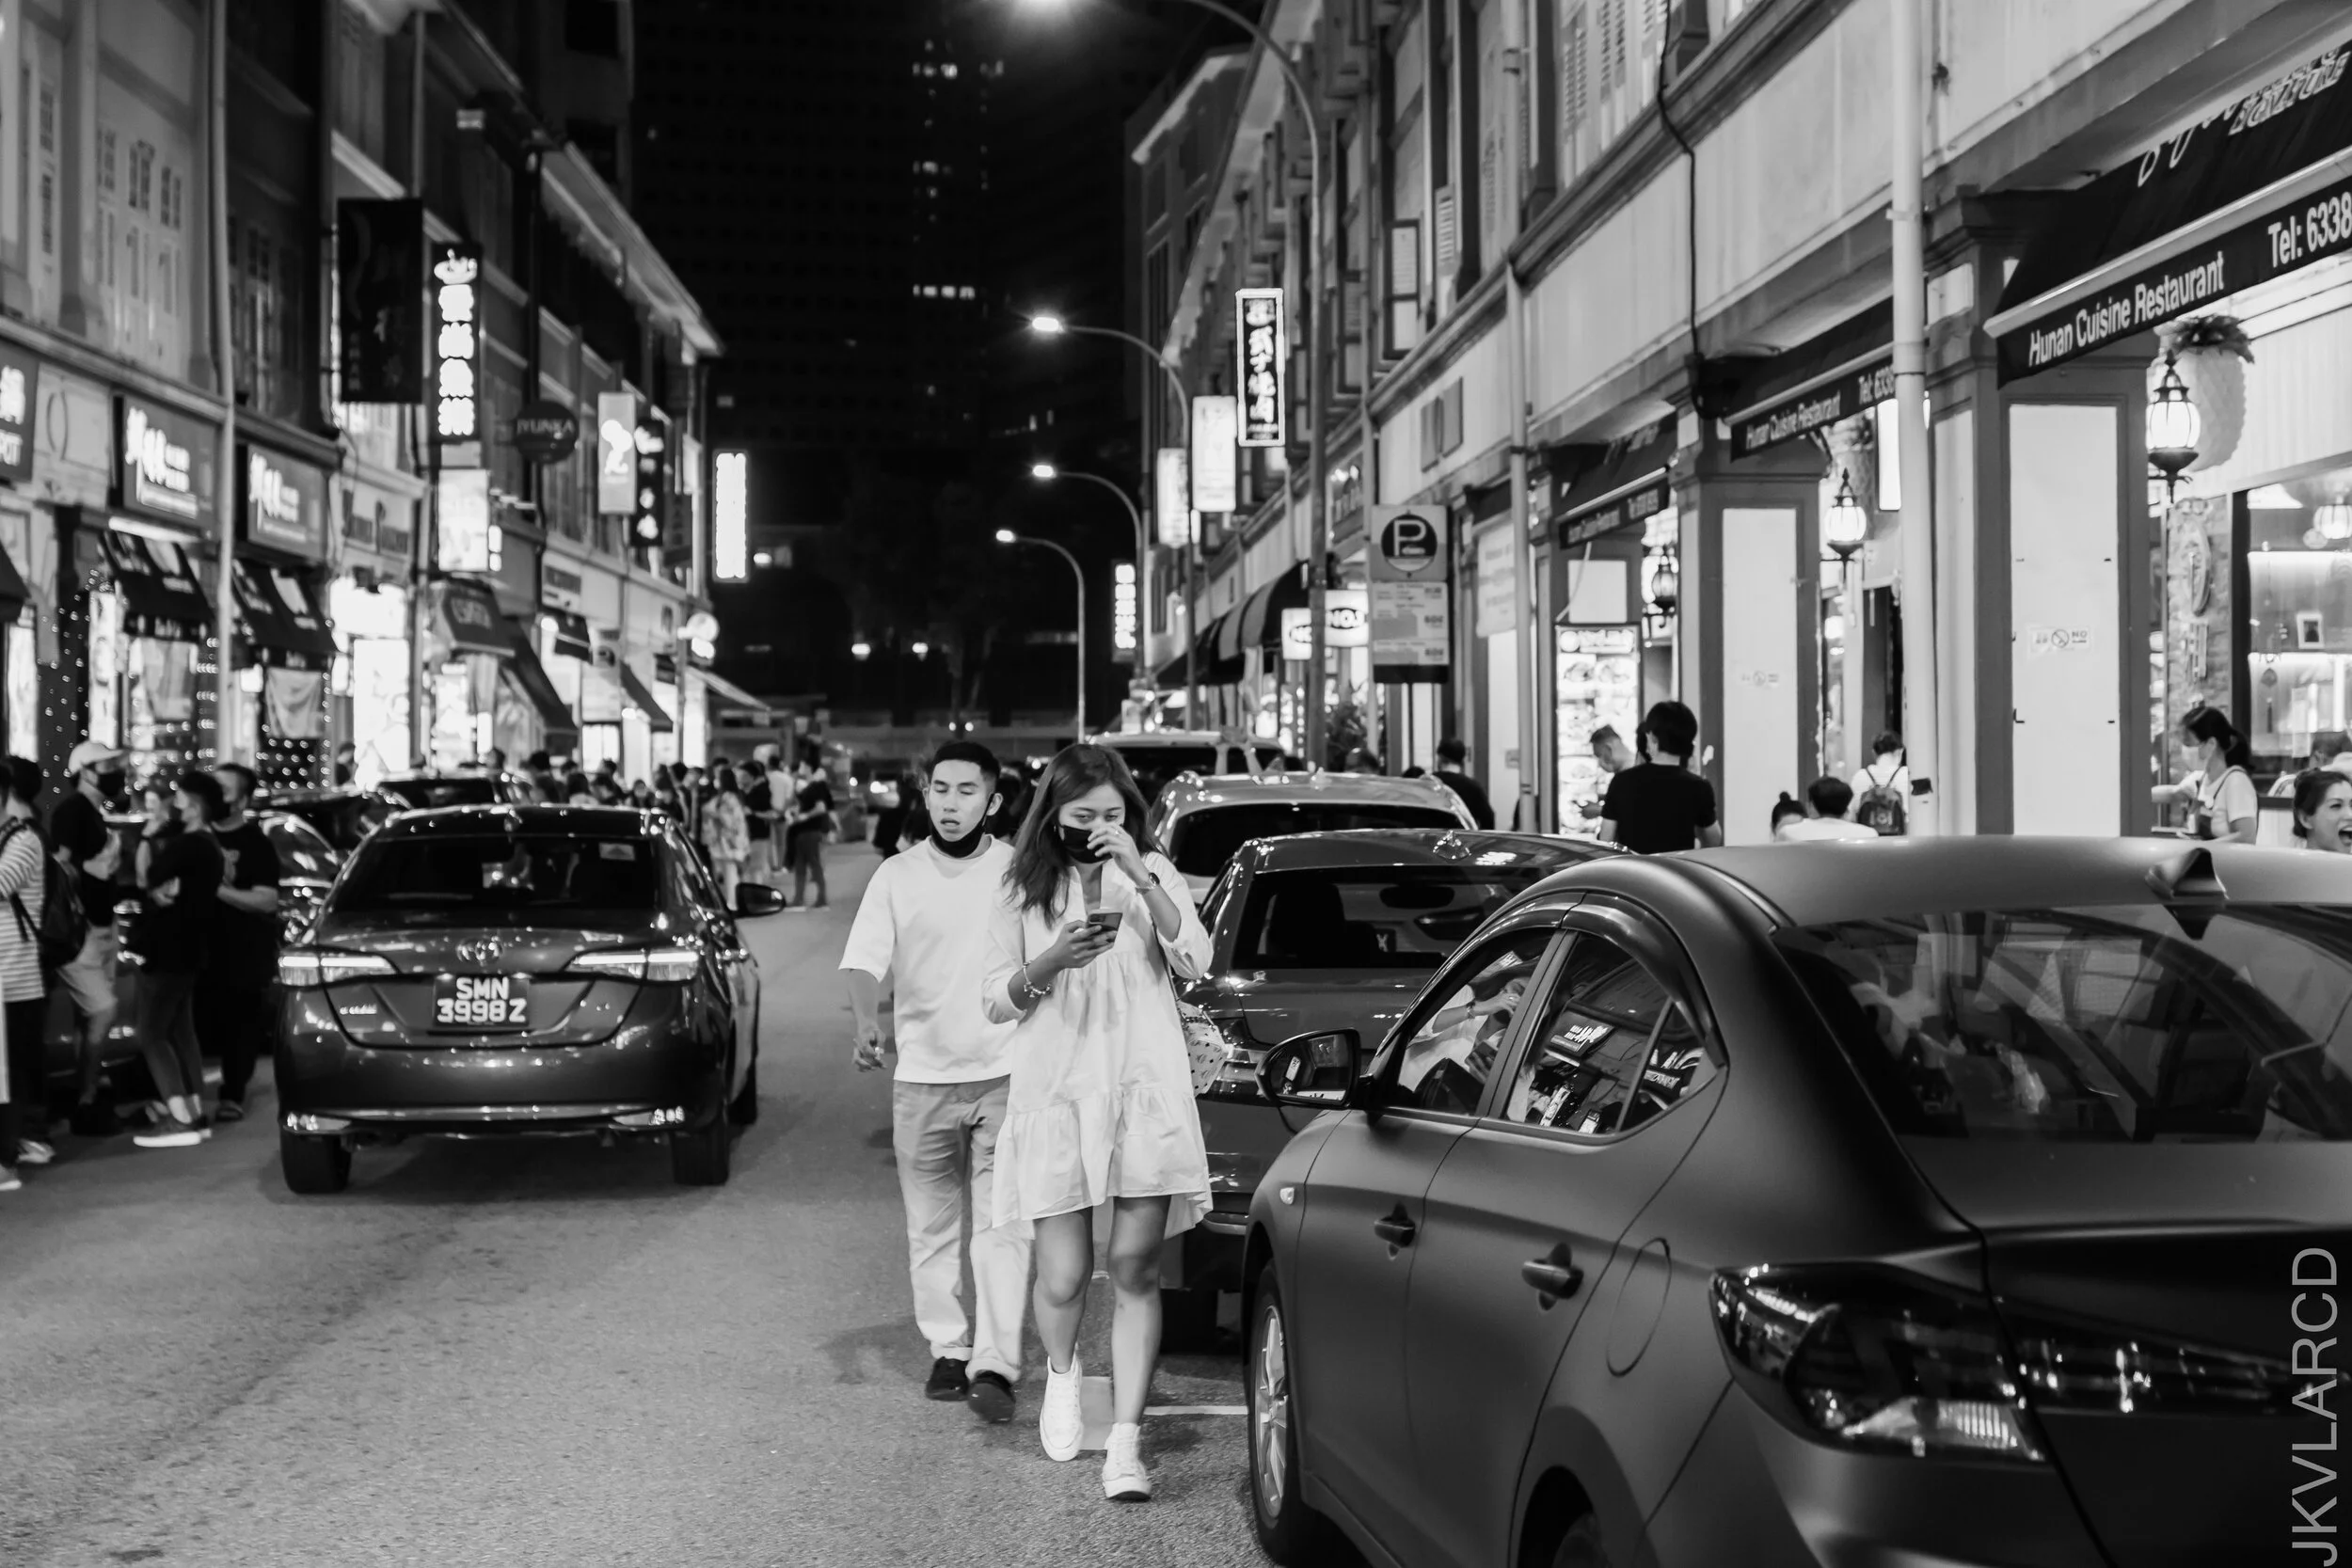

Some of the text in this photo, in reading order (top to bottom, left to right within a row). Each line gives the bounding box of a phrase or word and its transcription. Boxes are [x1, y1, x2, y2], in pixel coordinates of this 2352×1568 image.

[2028, 191, 2352, 368] Hunan Cuisine Restaurant Tel: 6338
[1393, 519, 1426, 556] P
[456, 977, 509, 1000] SMN
